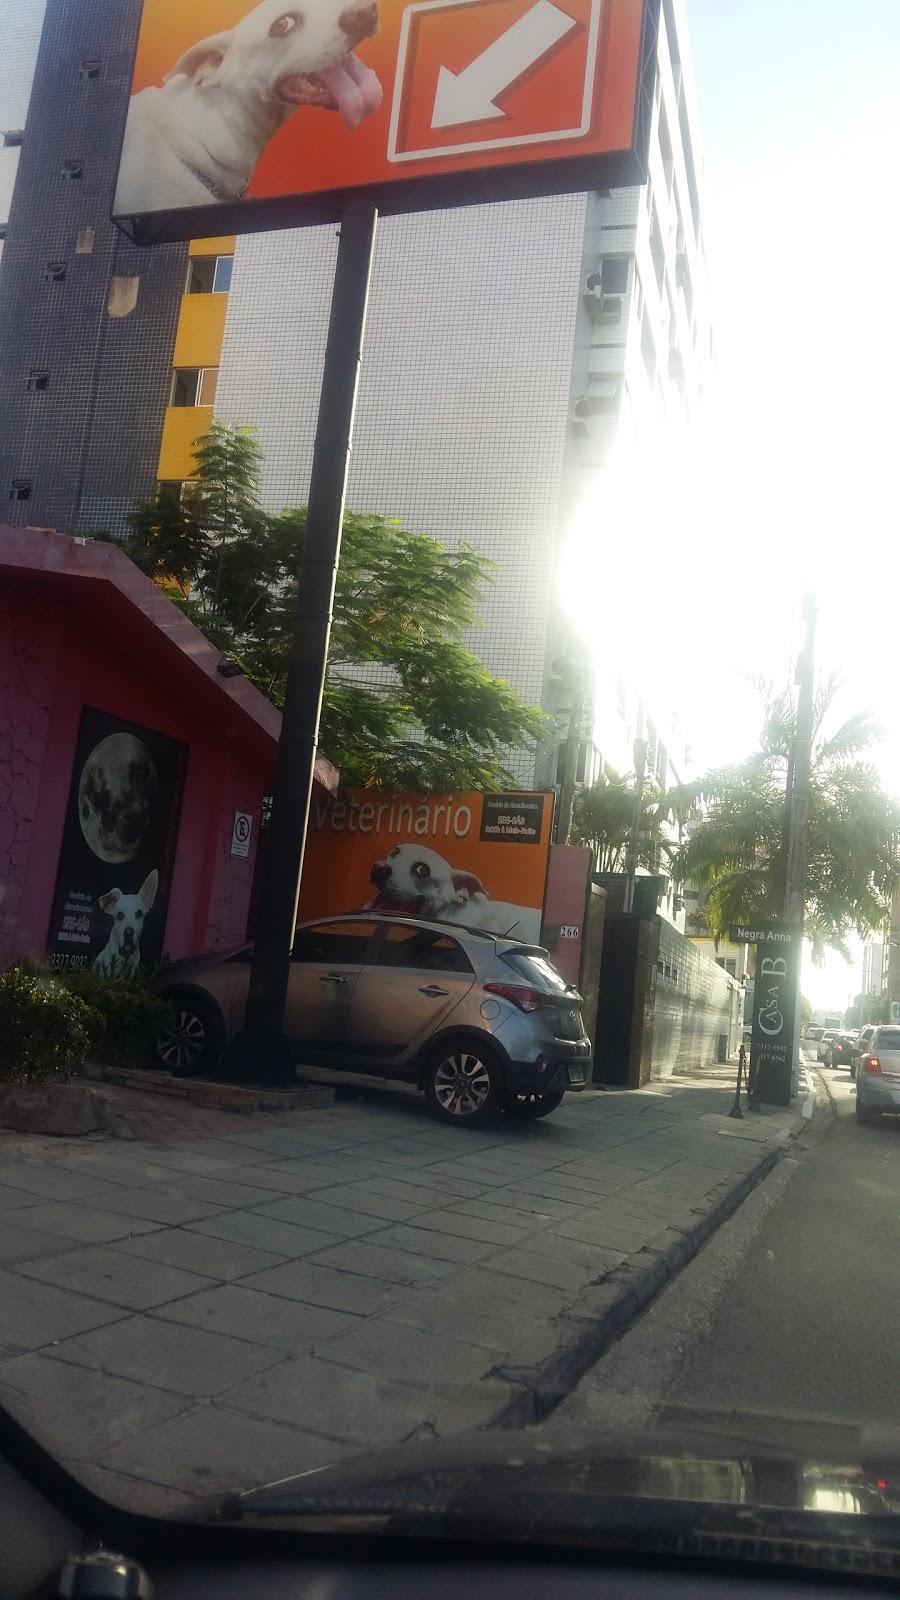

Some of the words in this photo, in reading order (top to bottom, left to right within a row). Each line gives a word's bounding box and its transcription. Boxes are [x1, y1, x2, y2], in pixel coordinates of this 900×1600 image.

[561, 926, 578, 938] 266
[737, 928, 765, 941] Negra
[766, 930, 792, 942] Anna
[761, 957, 787, 979] B
